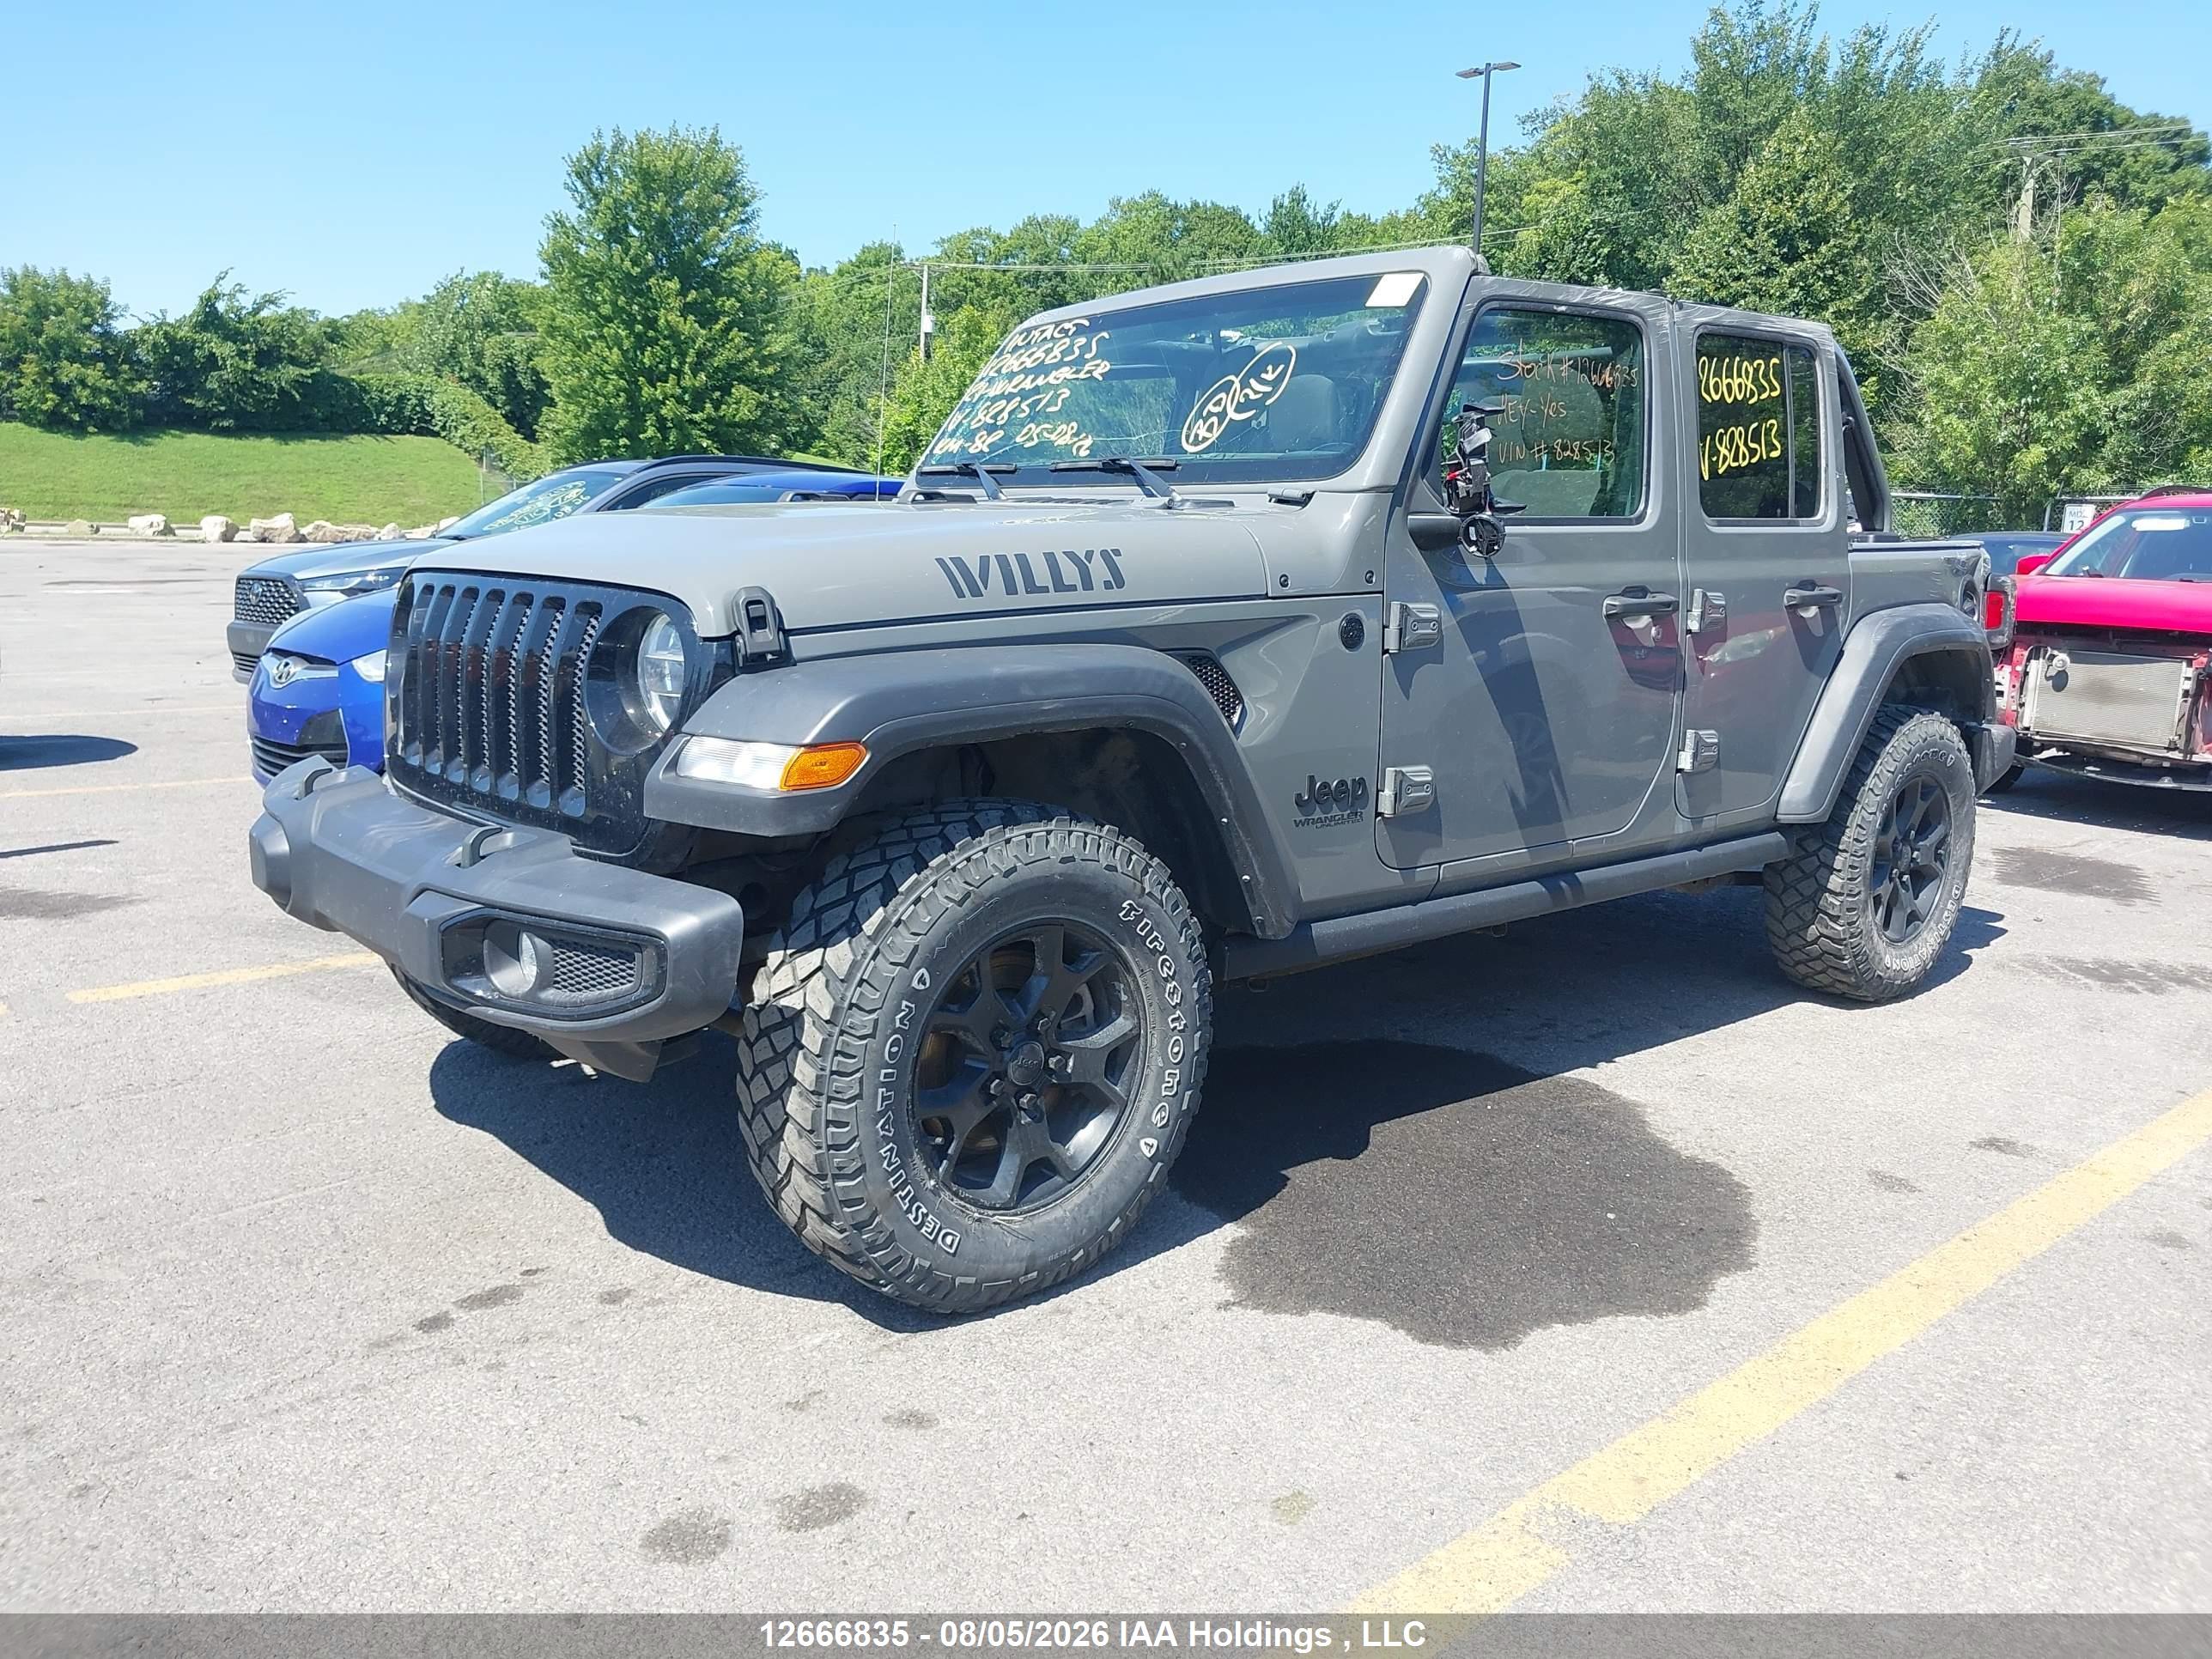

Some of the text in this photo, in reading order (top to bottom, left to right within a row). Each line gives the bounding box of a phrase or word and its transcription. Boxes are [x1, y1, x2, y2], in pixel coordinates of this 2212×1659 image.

[982, 331, 1110, 377] 12666835
[1497, 338, 1556, 384] Stock
[934, 548, 1126, 599] WILLYS
[1294, 774, 1369, 816] Jeep
[1293, 811, 1364, 828] WRANGLER
[876, 1000, 962, 1255] DESTINATION
